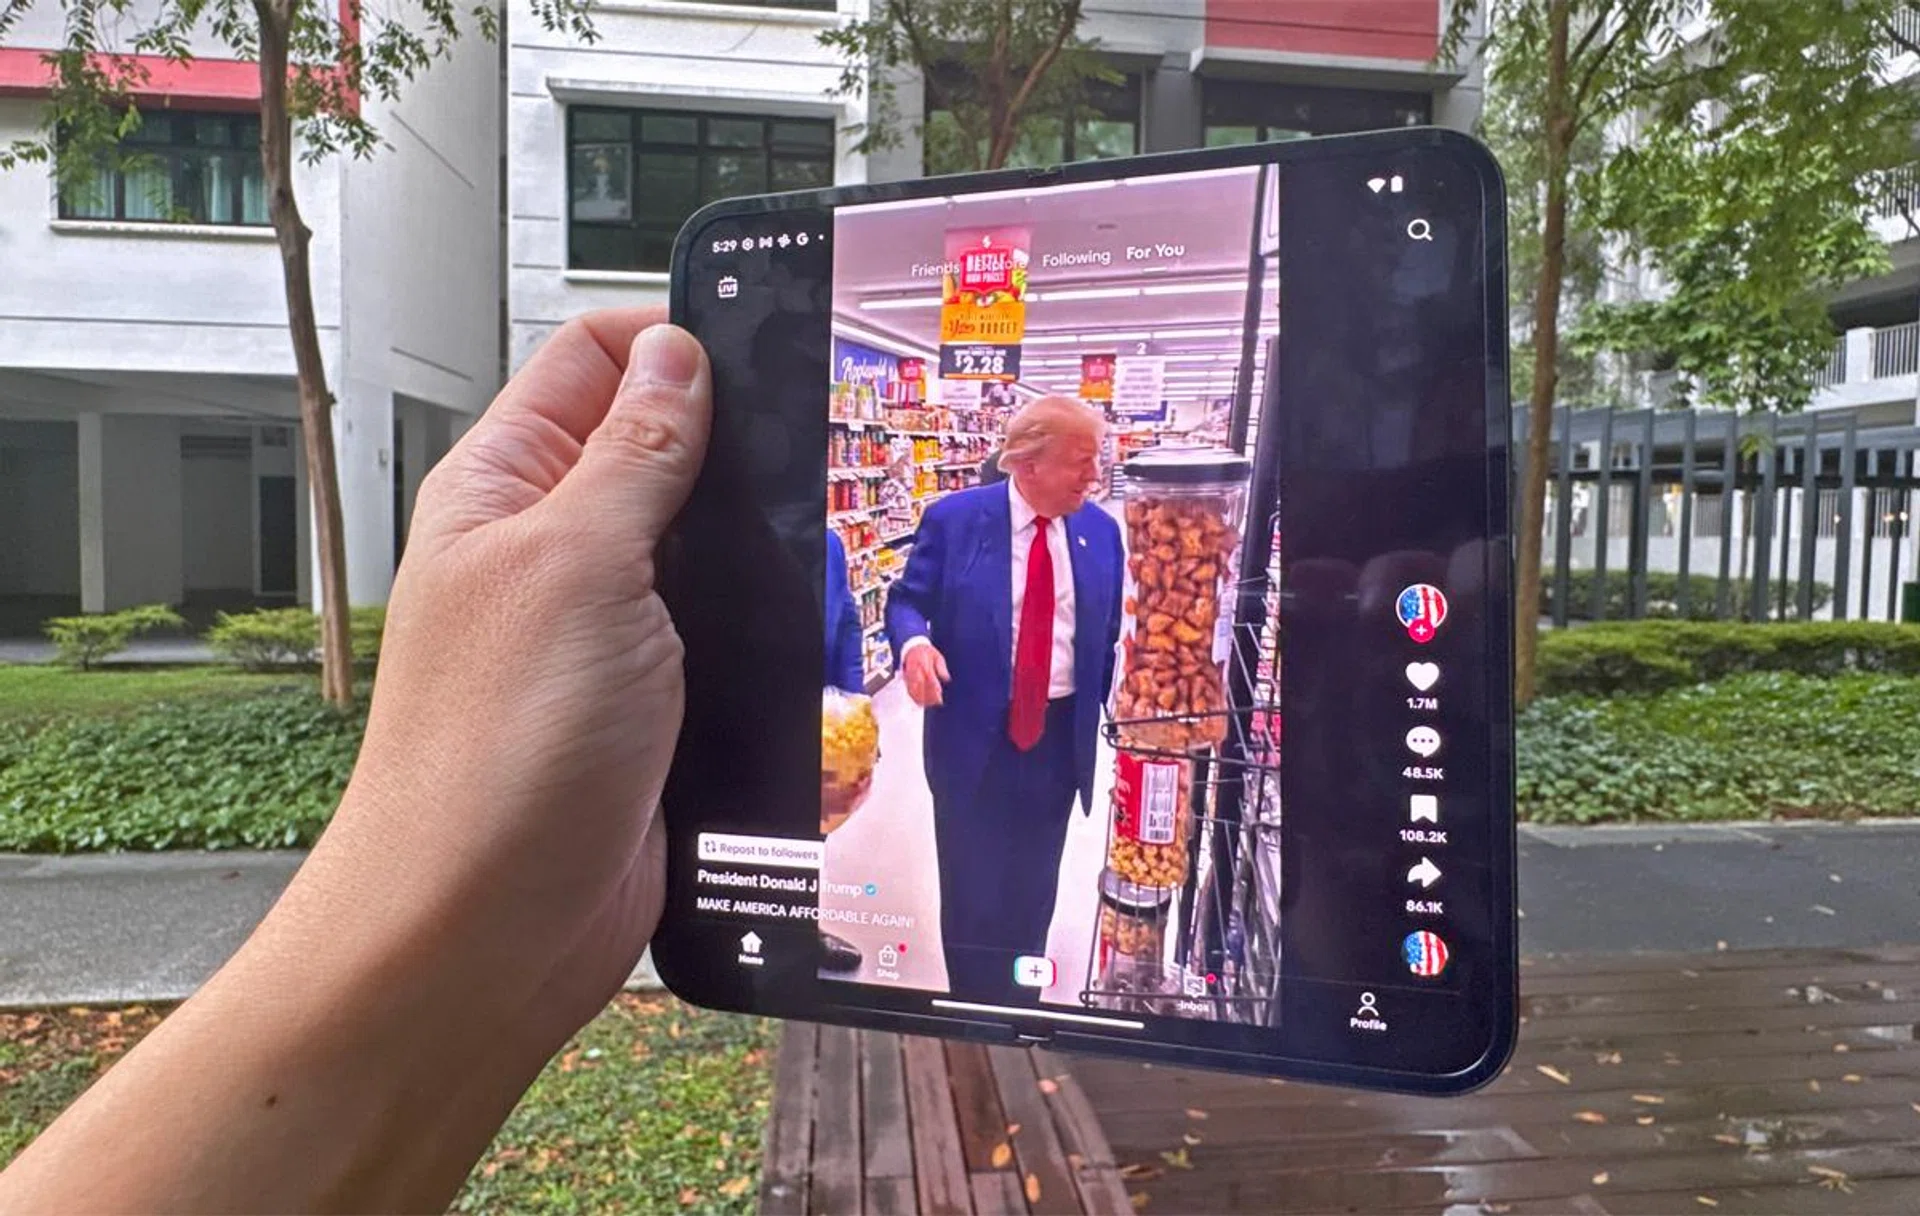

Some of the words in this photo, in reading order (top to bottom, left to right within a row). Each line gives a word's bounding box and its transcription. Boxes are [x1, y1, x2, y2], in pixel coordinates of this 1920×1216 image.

[712, 240, 738, 253] 5:29
[1126, 246, 1152, 260] For
[1155, 243, 1185, 257] You
[1042, 250, 1111, 266] Following
[911, 260, 960, 277] Friends
[1406, 697, 1438, 710] 1.7M
[1402, 766, 1444, 780] 48.5K
[1399, 829, 1448, 843] 108.2K
[719, 843, 755, 857] Repost
[758, 845, 769, 857] to
[771, 847, 819, 861] followers
[697, 869, 758, 886] President
[760, 874, 806, 892] Donald
[809, 879, 817, 893] J
[820, 880, 863, 897] Trump
[697, 897, 731, 912] MAKE
[733, 900, 787, 918] AMERICA
[789, 904, 869, 924] AFFORDABLE
[1406, 899, 1444, 914] 86.1K
[1180, 1001, 1210, 1013] Inbox
[1350, 1017, 1388, 1032] Profile
